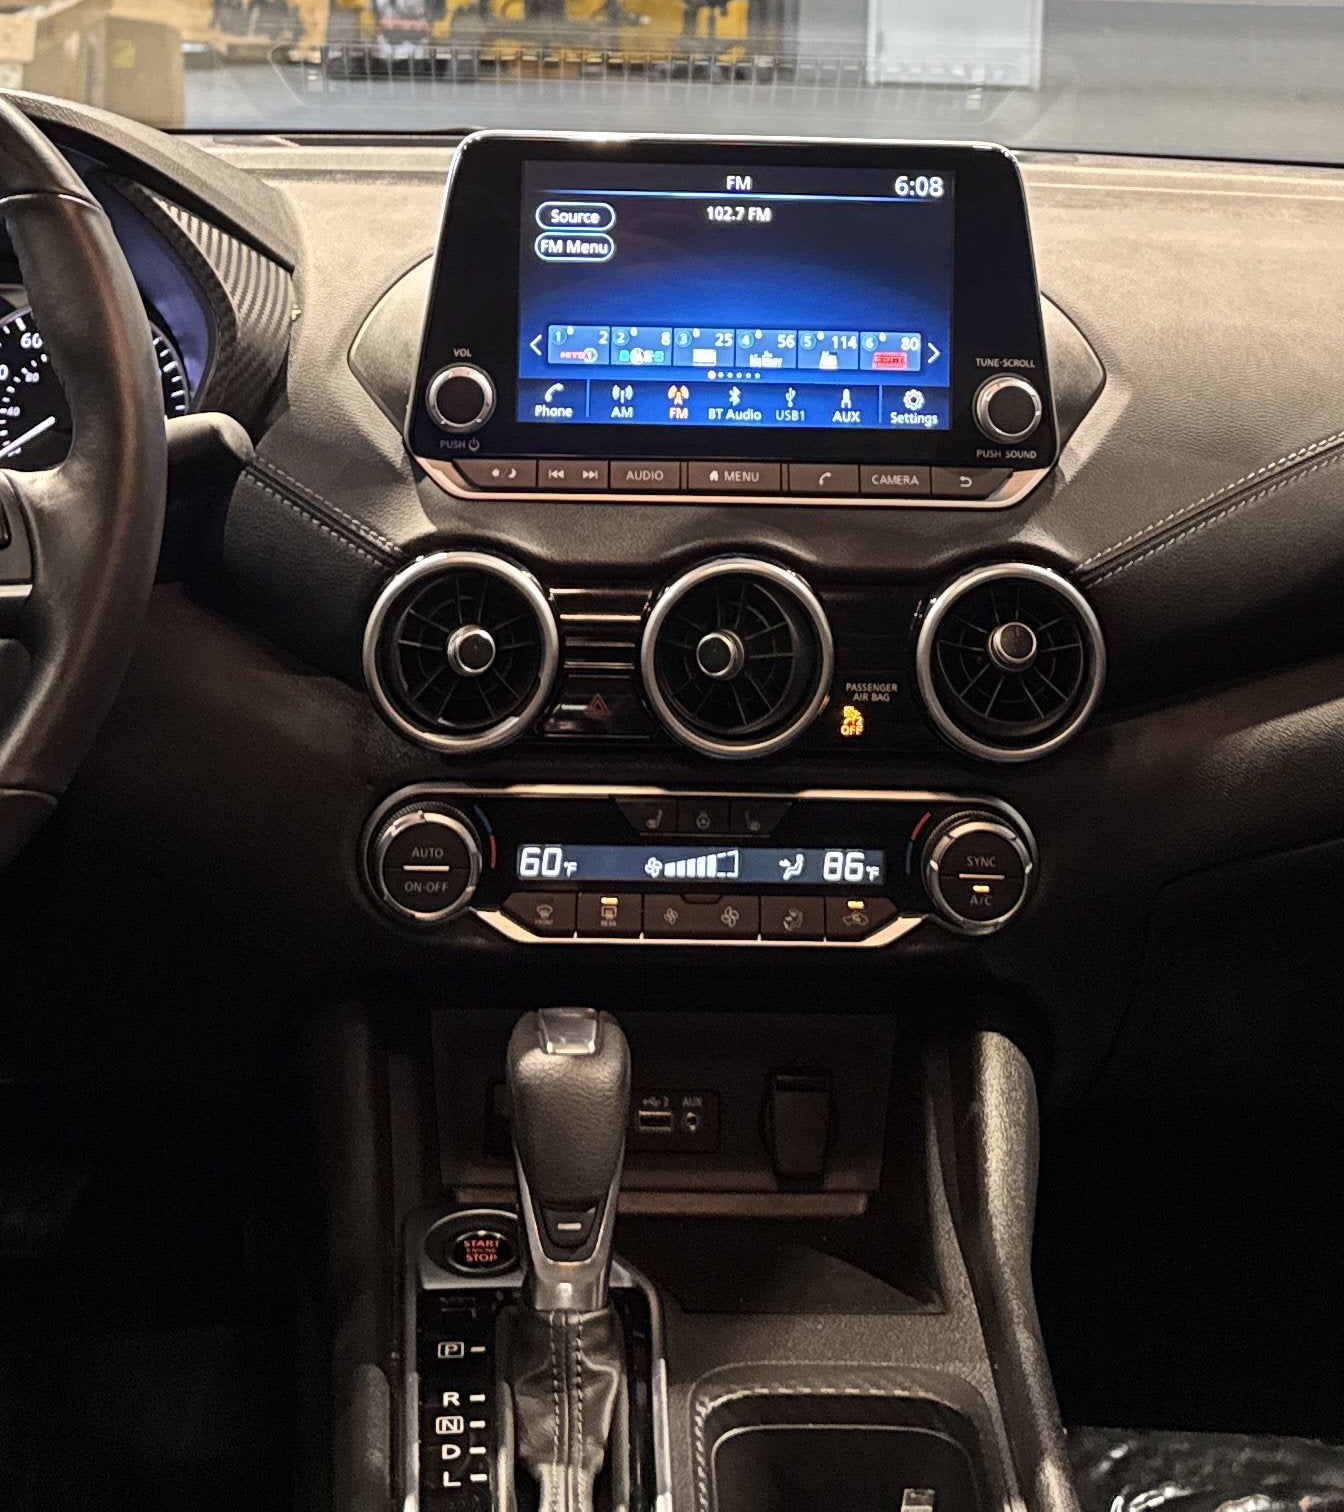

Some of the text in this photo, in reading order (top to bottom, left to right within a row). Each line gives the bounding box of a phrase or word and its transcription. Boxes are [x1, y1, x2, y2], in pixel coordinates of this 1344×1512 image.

[726, 175, 751, 191] FM
[894, 176, 944, 198] 6:08
[550, 208, 600, 226] Source
[706, 206, 772, 223] 102.7 FM
[541, 239, 608, 255] FM Menu
[20, 332, 43, 349] 60
[599, 331, 609, 344] 2
[616, 331, 626, 343] 2
[679, 333, 688, 345] 3
[715, 333, 734, 347] 25
[741, 334, 751, 346] 4
[777, 334, 796, 349] 56
[804, 335, 812, 347] 5
[830, 335, 858, 350] 114
[865, 336, 874, 349] 6
[900, 337, 919, 352] 80
[453, 348, 472, 359] VOL
[534, 403, 573, 420] Phone
[611, 405, 634, 420] AM
[669, 406, 689, 420] FM
[708, 407, 762, 422] BT Audio
[775, 408, 806, 423] USB1
[832, 410, 861, 425] AUX
[890, 410, 938, 429] Settings
[439, 439, 467, 451] PUSH
[976, 449, 1037, 461] PUSH SOUND
[625, 469, 664, 482] AUDIO
[723, 470, 760, 484] MENU
[871, 474, 920, 487] CAMERA
[846, 683, 898, 693] PASSENGER
[853, 692, 890, 703] AIR BAG
[841, 725, 863, 736] OFF
[411, 846, 445, 859] AUTO
[966, 855, 997, 868] SYNC
[969, 893, 993, 907] A/C
[463, 1239, 500, 1248] START
[465, 1253, 498, 1263] STOP
[444, 1344, 458, 1356] P
[442, 1391, 460, 1406] R
[441, 1418, 459, 1431] N
[441, 1444, 461, 1460] D
[443, 1472, 461, 1487] L
